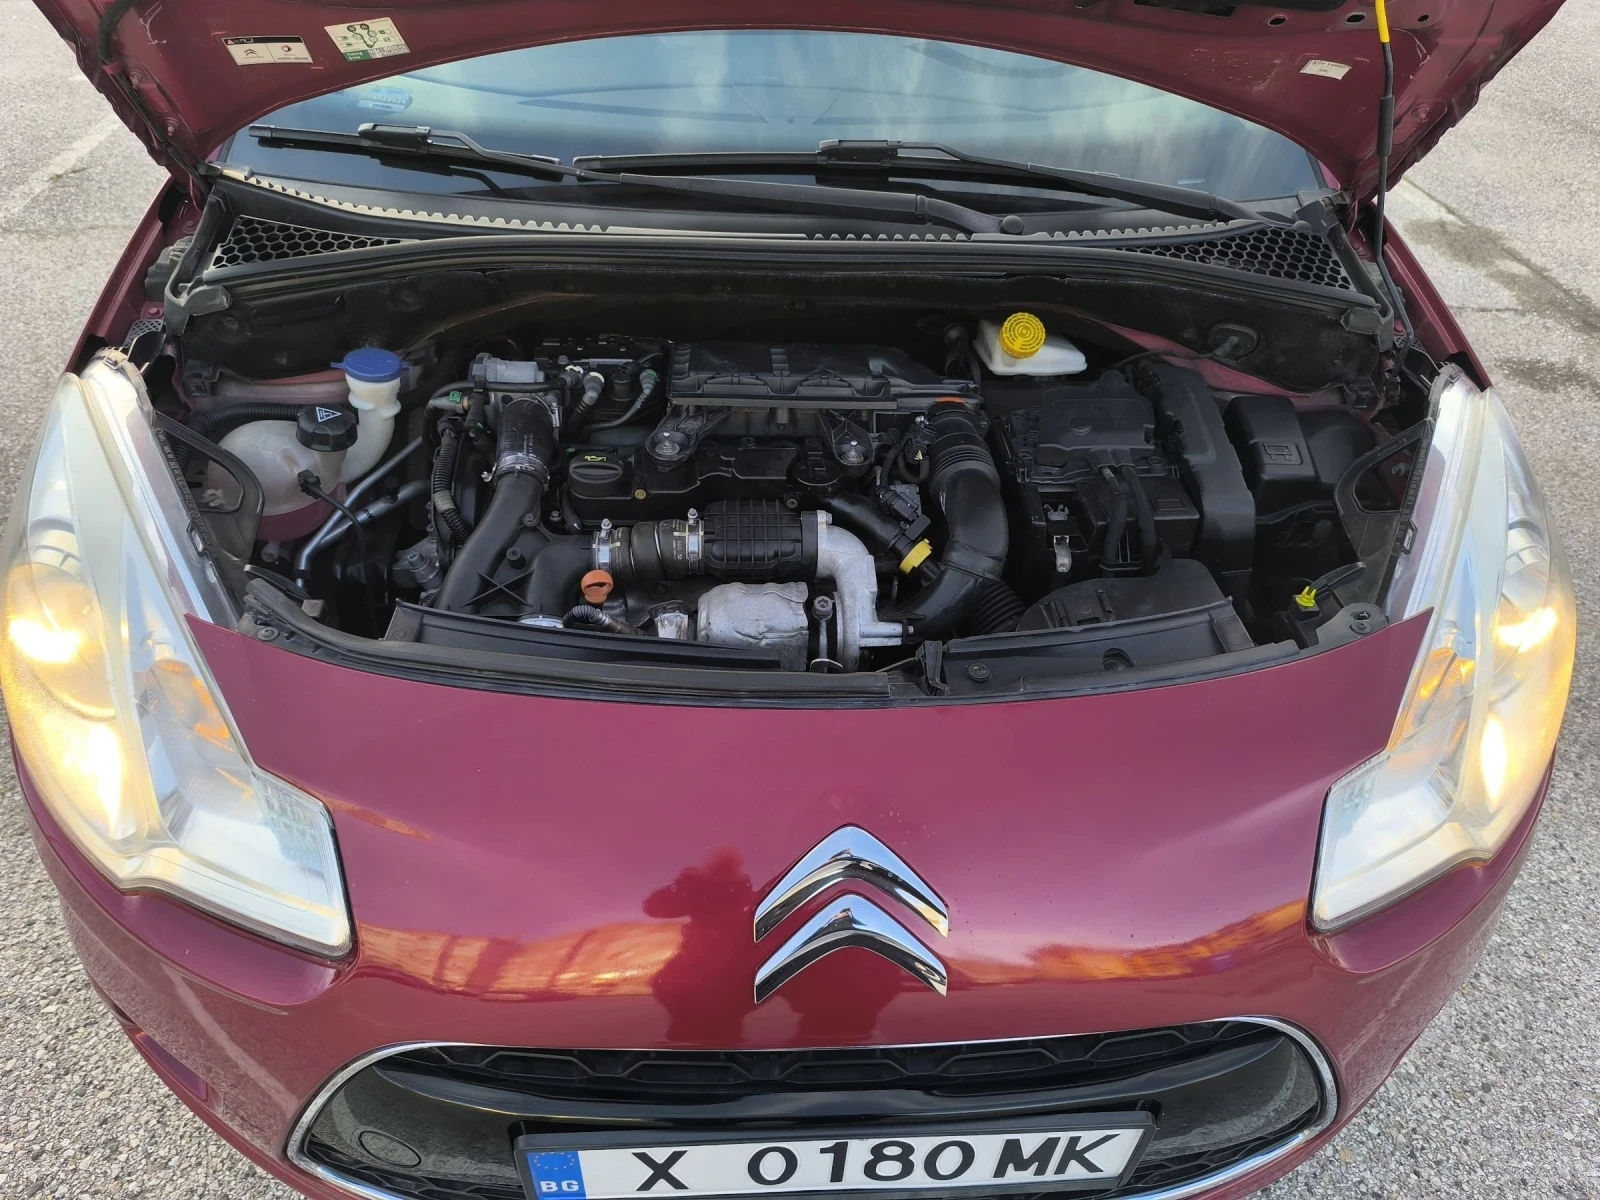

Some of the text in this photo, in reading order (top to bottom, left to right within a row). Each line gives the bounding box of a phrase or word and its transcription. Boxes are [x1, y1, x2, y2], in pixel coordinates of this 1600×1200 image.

[631, 1133, 1121, 1192] X 0180 MK
[540, 1180, 580, 1193] BG
